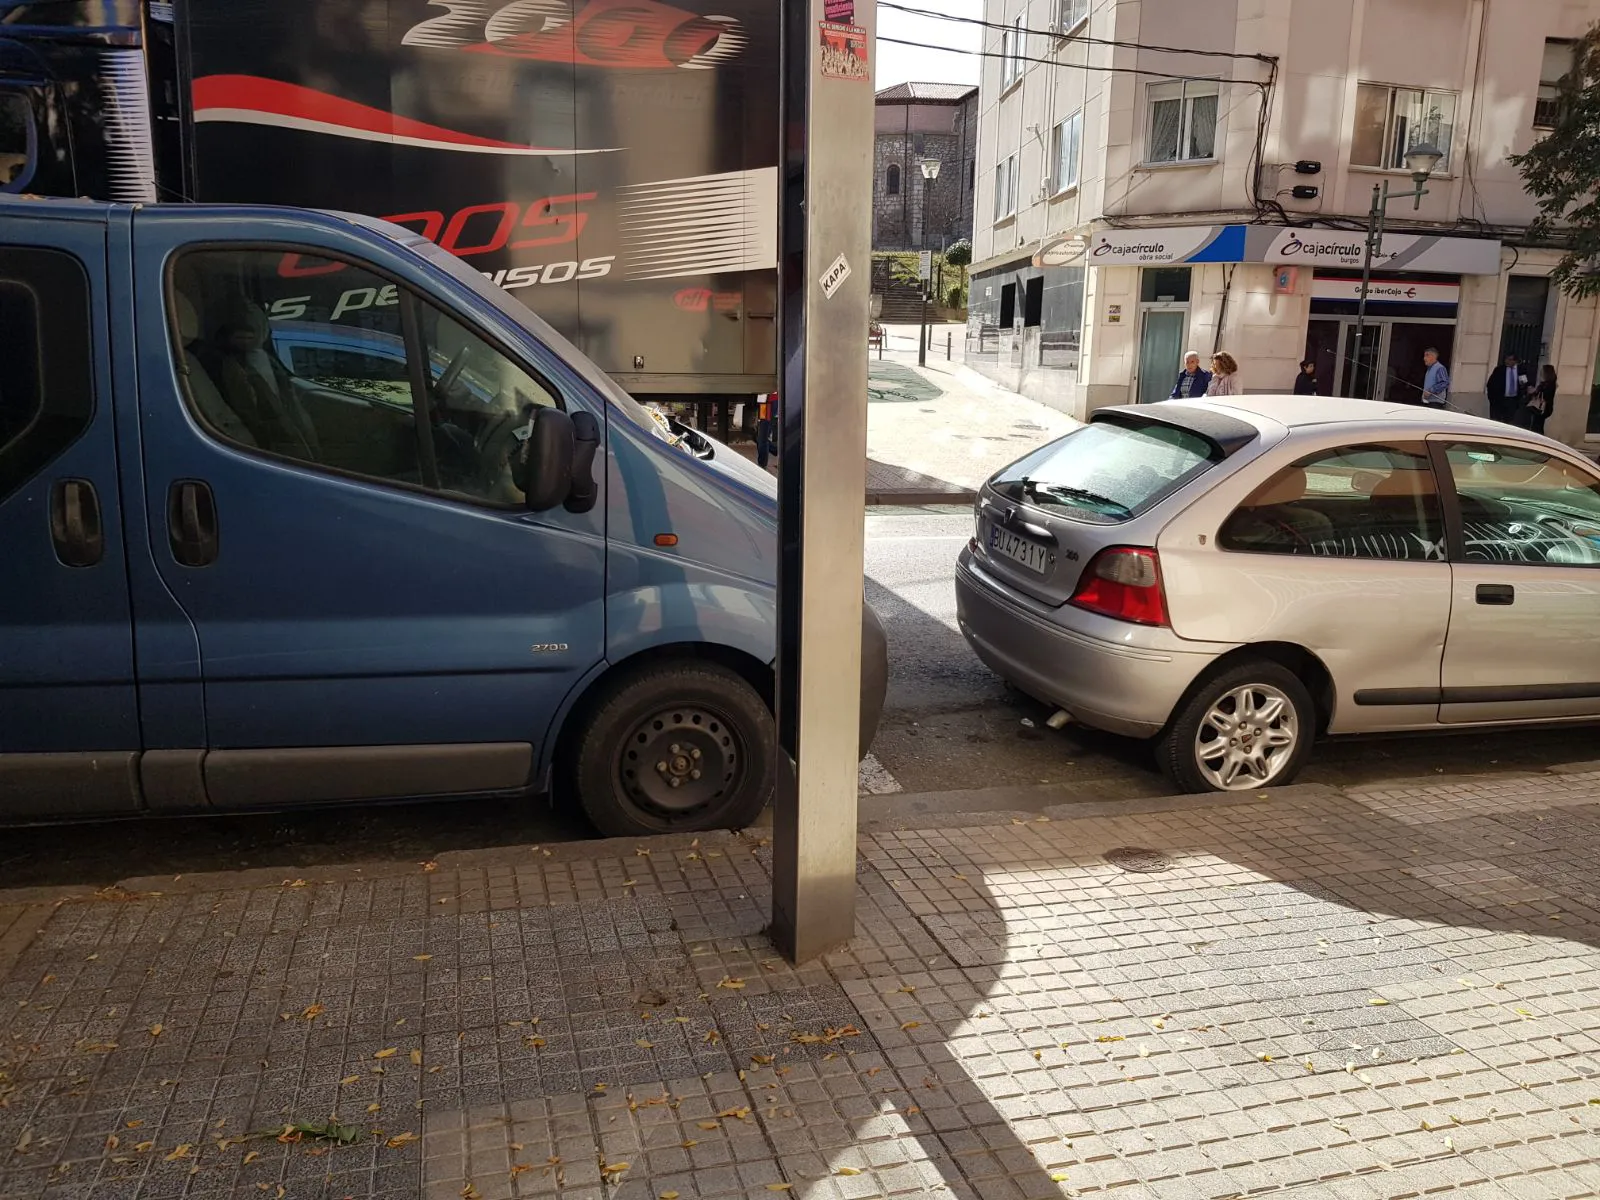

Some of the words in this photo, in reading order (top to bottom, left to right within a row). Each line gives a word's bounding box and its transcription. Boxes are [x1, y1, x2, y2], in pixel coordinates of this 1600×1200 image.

[1112, 243, 1164, 256] cajacírculo
[1302, 242, 1361, 256] cajacírculo
[823, 263, 846, 291] KAPA
[531, 643, 568, 652] 2700
